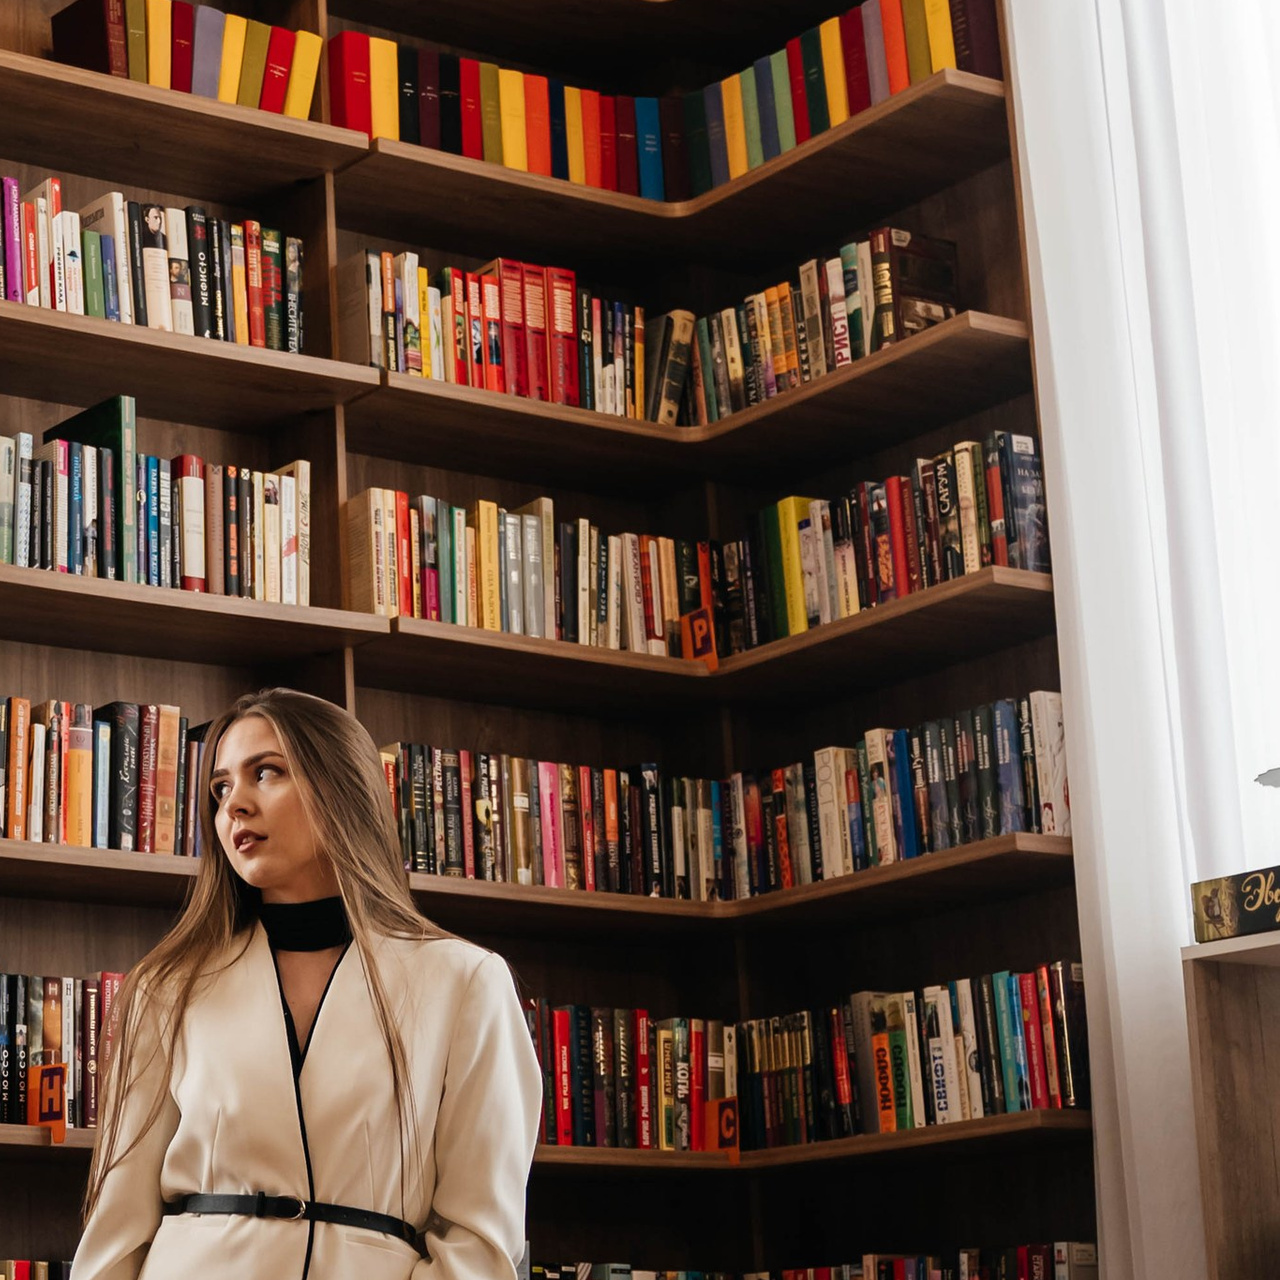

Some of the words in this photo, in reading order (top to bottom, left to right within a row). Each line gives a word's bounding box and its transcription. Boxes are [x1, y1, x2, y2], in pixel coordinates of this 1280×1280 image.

[198, 252, 209, 306] МЕФИСТО
[288, 293, 297, 333] ВНЕСИТЕ
[289, 336, 298, 354] ТЕЛ
[936, 462, 948, 514] САРУМ
[876, 1048, 892, 1112] САФОН
[892, 1045, 906, 1108] САФОН
[932, 1054, 948, 1112] СВИФТ
